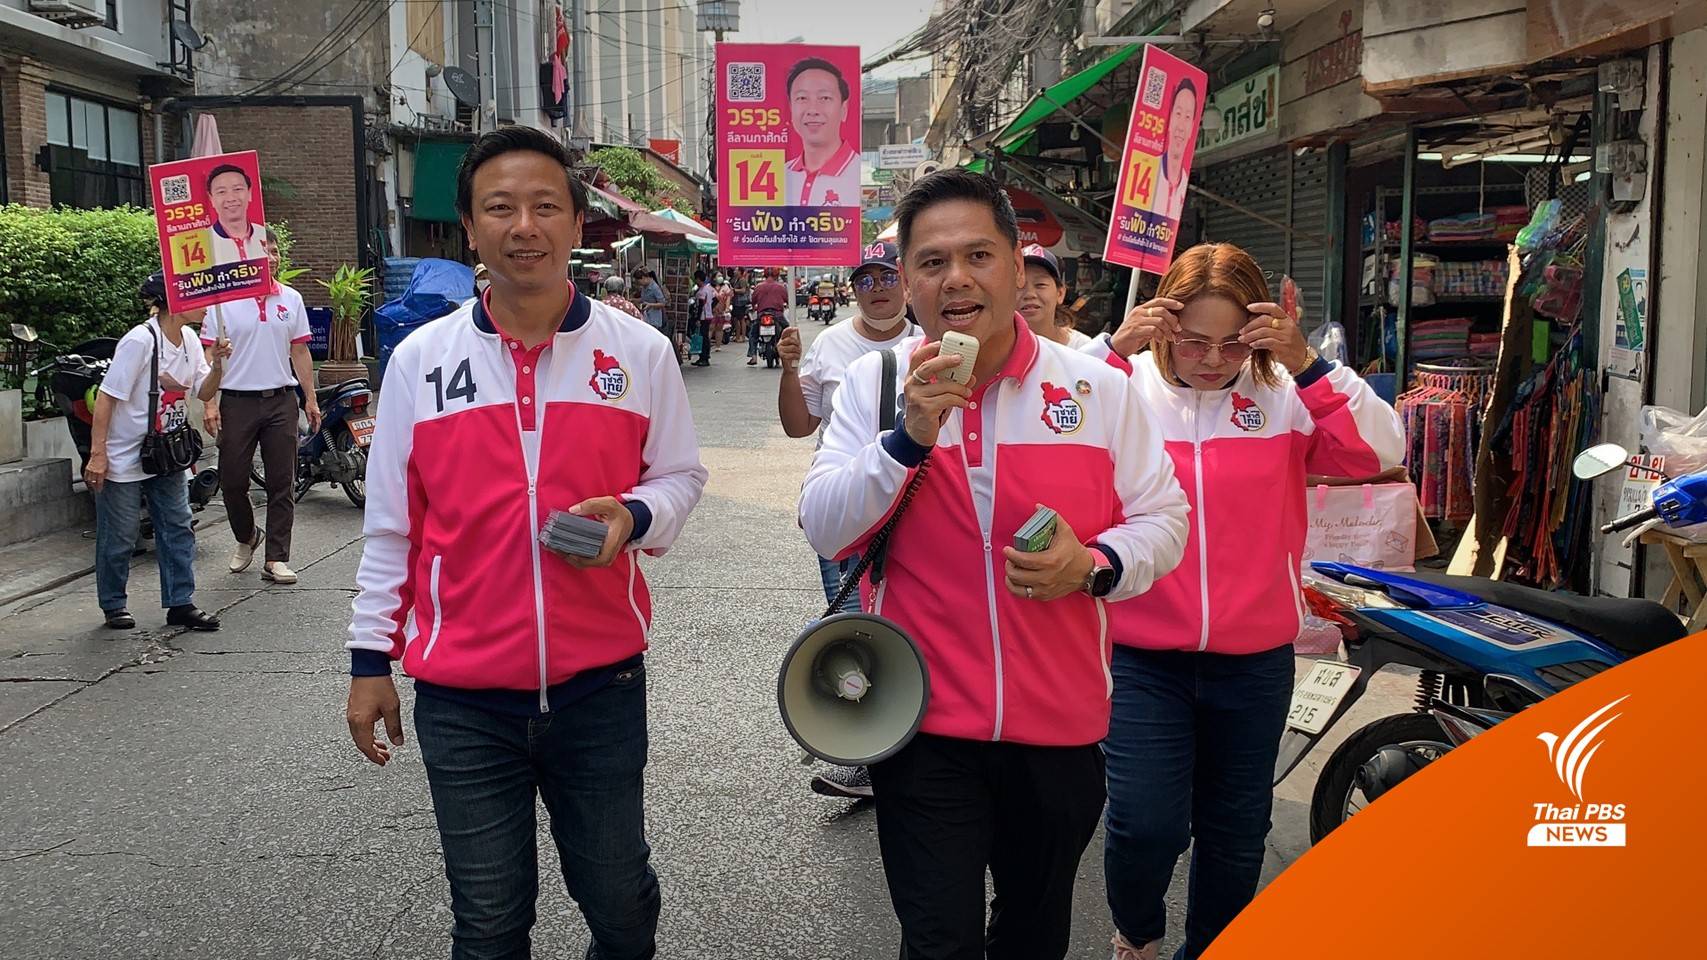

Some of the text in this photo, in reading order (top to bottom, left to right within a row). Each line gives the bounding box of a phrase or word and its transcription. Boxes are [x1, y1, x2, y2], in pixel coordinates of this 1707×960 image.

[736, 160, 778, 201] 14
[1129, 162, 1152, 205] 14
[181, 241, 207, 268] 14
[864, 243, 885, 259] 14
[425, 357, 478, 413] 14
[1052, 410, 1077, 424] ไทย
[1289, 704, 1318, 724] 215
